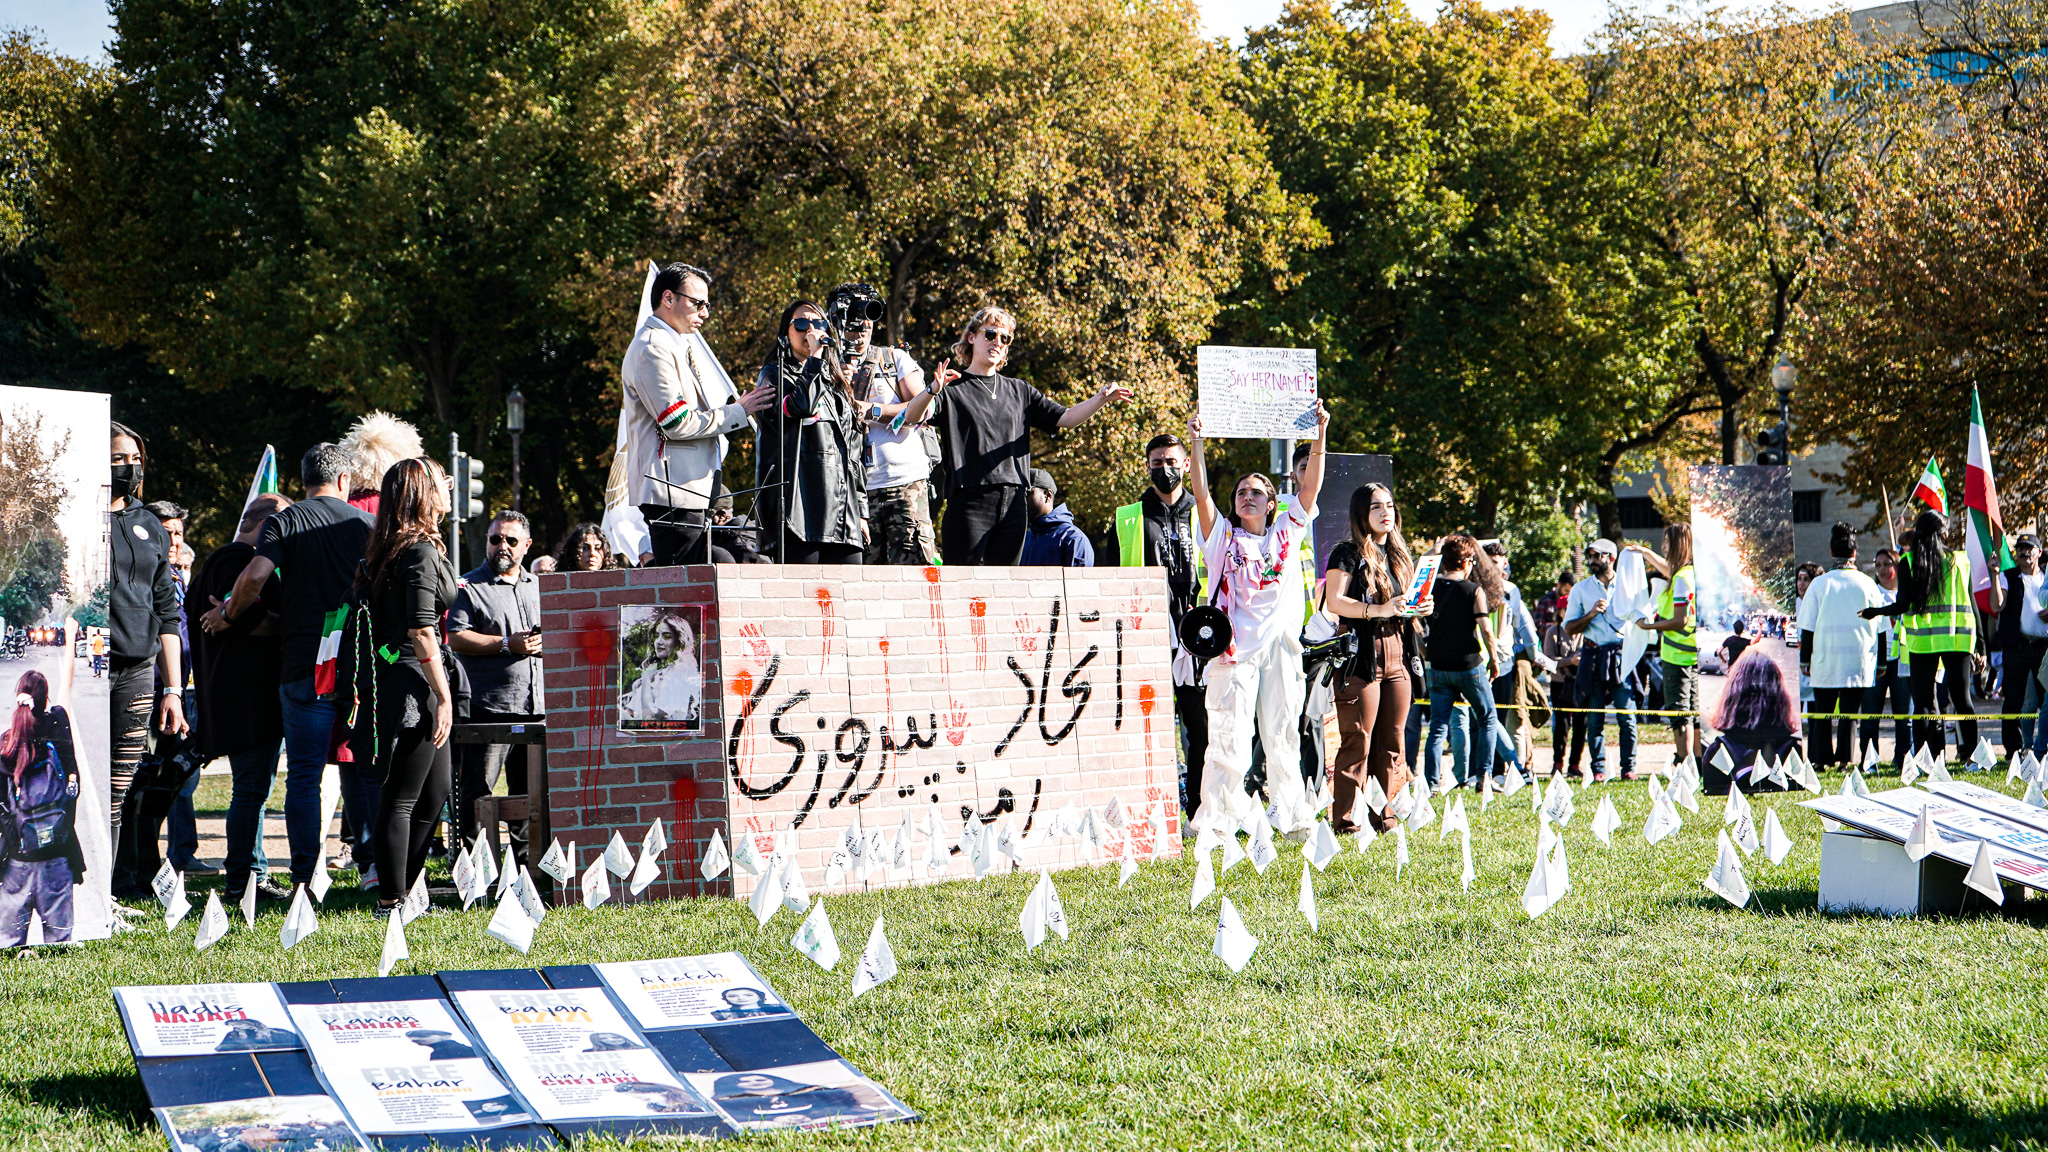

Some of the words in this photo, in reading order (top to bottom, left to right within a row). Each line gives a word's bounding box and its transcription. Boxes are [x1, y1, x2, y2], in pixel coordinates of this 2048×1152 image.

[1229, 369, 1250, 387] SAY
[1251, 371, 1272, 390] HER
[1271, 372, 1308, 392] NAME!
[1252, 388, 1274, 402] HIS
[629, 957, 720, 978] FREE
[139, 986, 182, 994] SAY
[191, 985, 235, 994] HER
[143, 993, 239, 1006] NAME
[489, 992, 584, 1008] FREE
[147, 999, 244, 1016] Hadis
[314, 1003, 358, 1012] SAY
[369, 1002, 410, 1010] HIS
[153, 1010, 248, 1024] NAJAFI
[318, 1008, 415, 1021] NAME
[510, 1011, 593, 1024] AZIZI
[328, 1021, 424, 1031] AGHAEE
[523, 1055, 566, 1063] SAY
[576, 1052, 622, 1061] HER
[360, 1063, 463, 1083] FREE
[530, 1060, 630, 1074] NAME
[371, 1078, 464, 1091] Bahar
